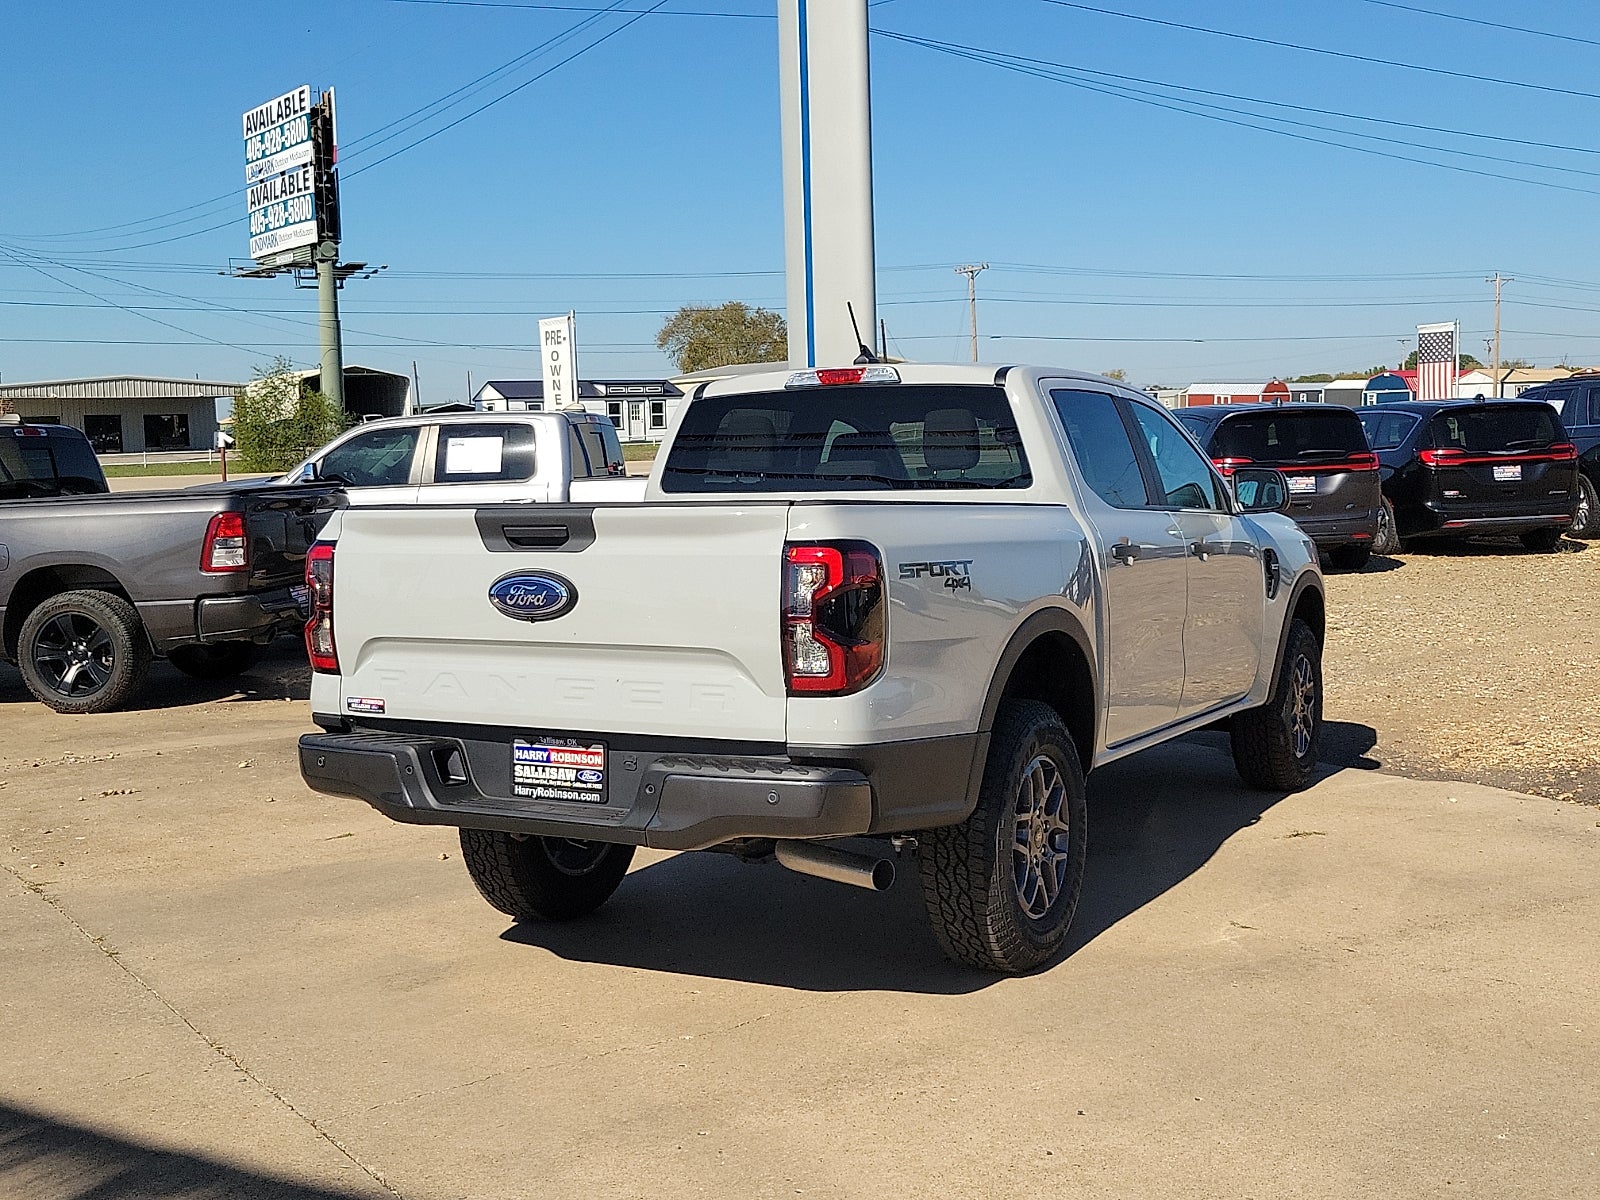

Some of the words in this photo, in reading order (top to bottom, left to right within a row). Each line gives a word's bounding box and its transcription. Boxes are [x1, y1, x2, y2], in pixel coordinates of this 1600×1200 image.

[246, 88, 306, 137] AVAILABLE
[246, 115, 309, 163] 405-928-5800
[249, 168, 311, 211] AVAILABLE
[250, 194, 312, 236] 405-928-5800
[545, 330, 566, 346] PRE-
[550, 350, 562, 411] OWNE
[898, 559, 973, 580] SPORT
[506, 584, 547, 605] Ford
[373, 667, 737, 715] RANGER
[515, 750, 549, 761] HARRY
[551, 752, 602, 764] ROBINSON
[514, 765, 577, 781] SALLISAW
[514, 784, 600, 802] HarryRobinson.com
